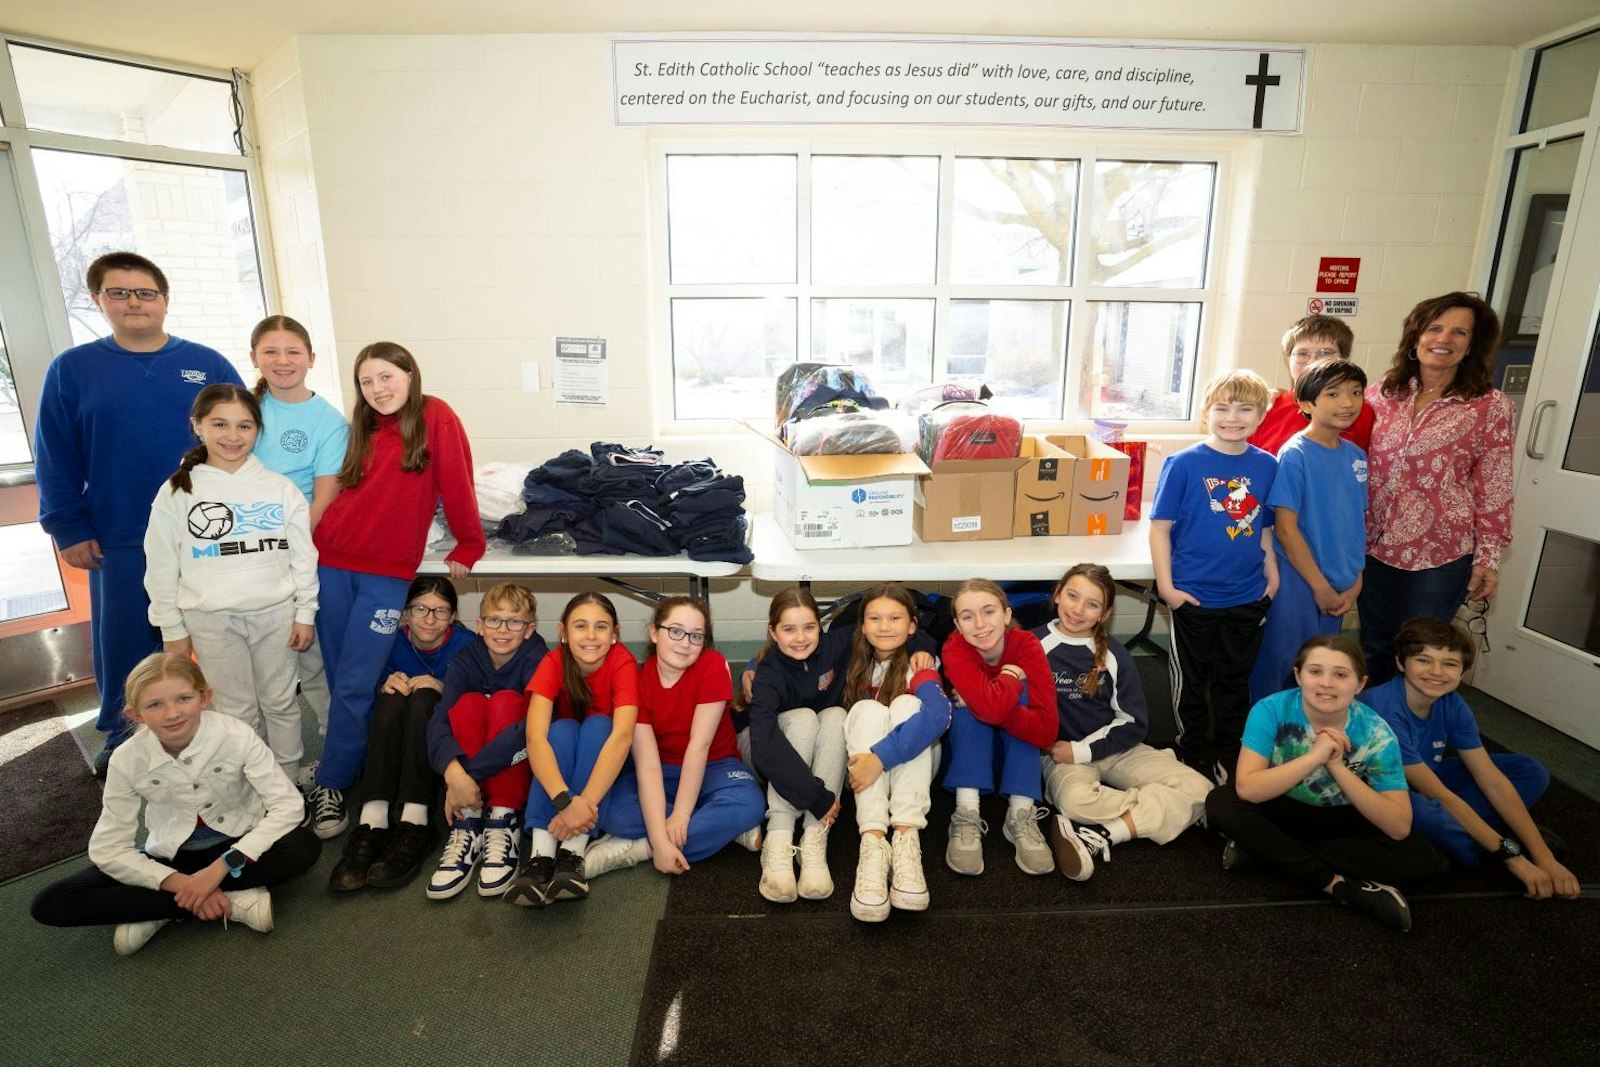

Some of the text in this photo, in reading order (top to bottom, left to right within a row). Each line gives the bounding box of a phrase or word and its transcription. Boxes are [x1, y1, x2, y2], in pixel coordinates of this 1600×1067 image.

[634, 61, 1194, 86] St. Edith Catholic School “teaches as Jesus did” with love, care, and discipline,
[620, 90, 1206, 114] centered on the Eucharist, and focusing on our students, our gifts, and our future.
[1052, 670, 1072, 684] New
